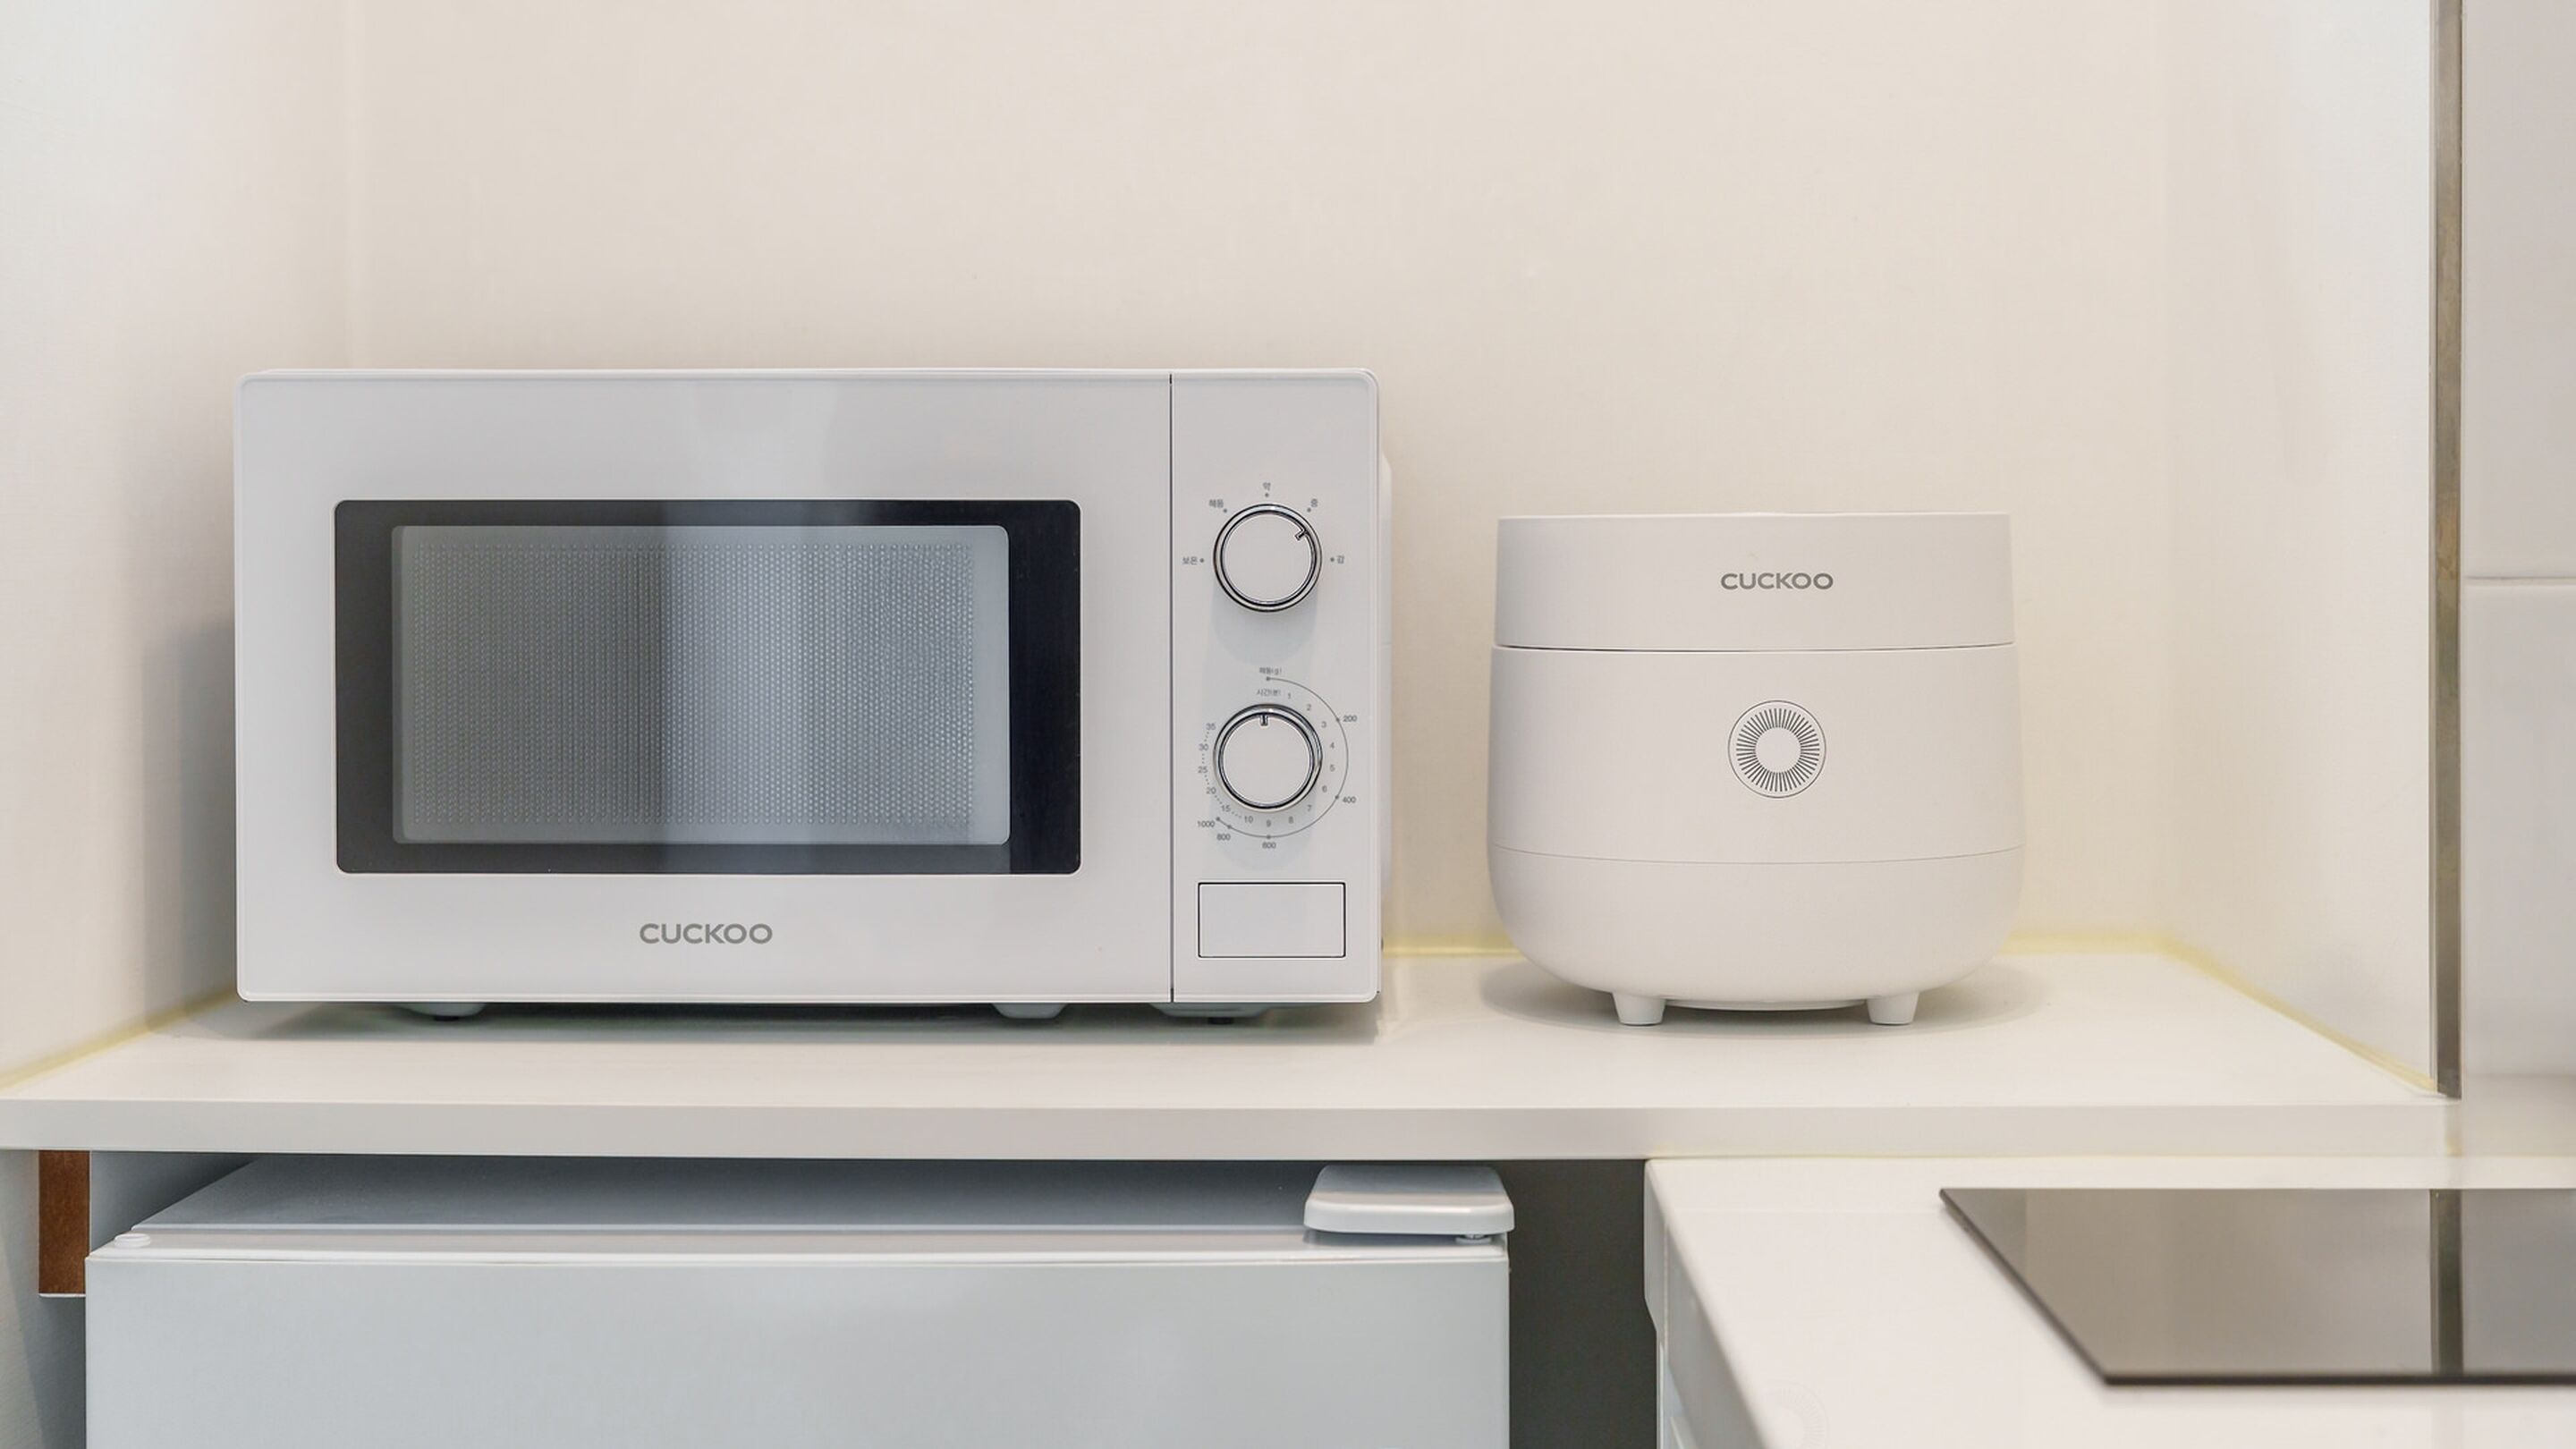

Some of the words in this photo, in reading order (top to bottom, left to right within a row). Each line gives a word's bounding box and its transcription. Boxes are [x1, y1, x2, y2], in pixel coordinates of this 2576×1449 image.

[1720, 572, 1834, 590] CUCKOO
[1198, 766, 1208, 774] 25
[1330, 764, 1335, 772] 5
[1322, 784, 1327, 792] 6
[640, 923, 773, 945] CUCKOO
